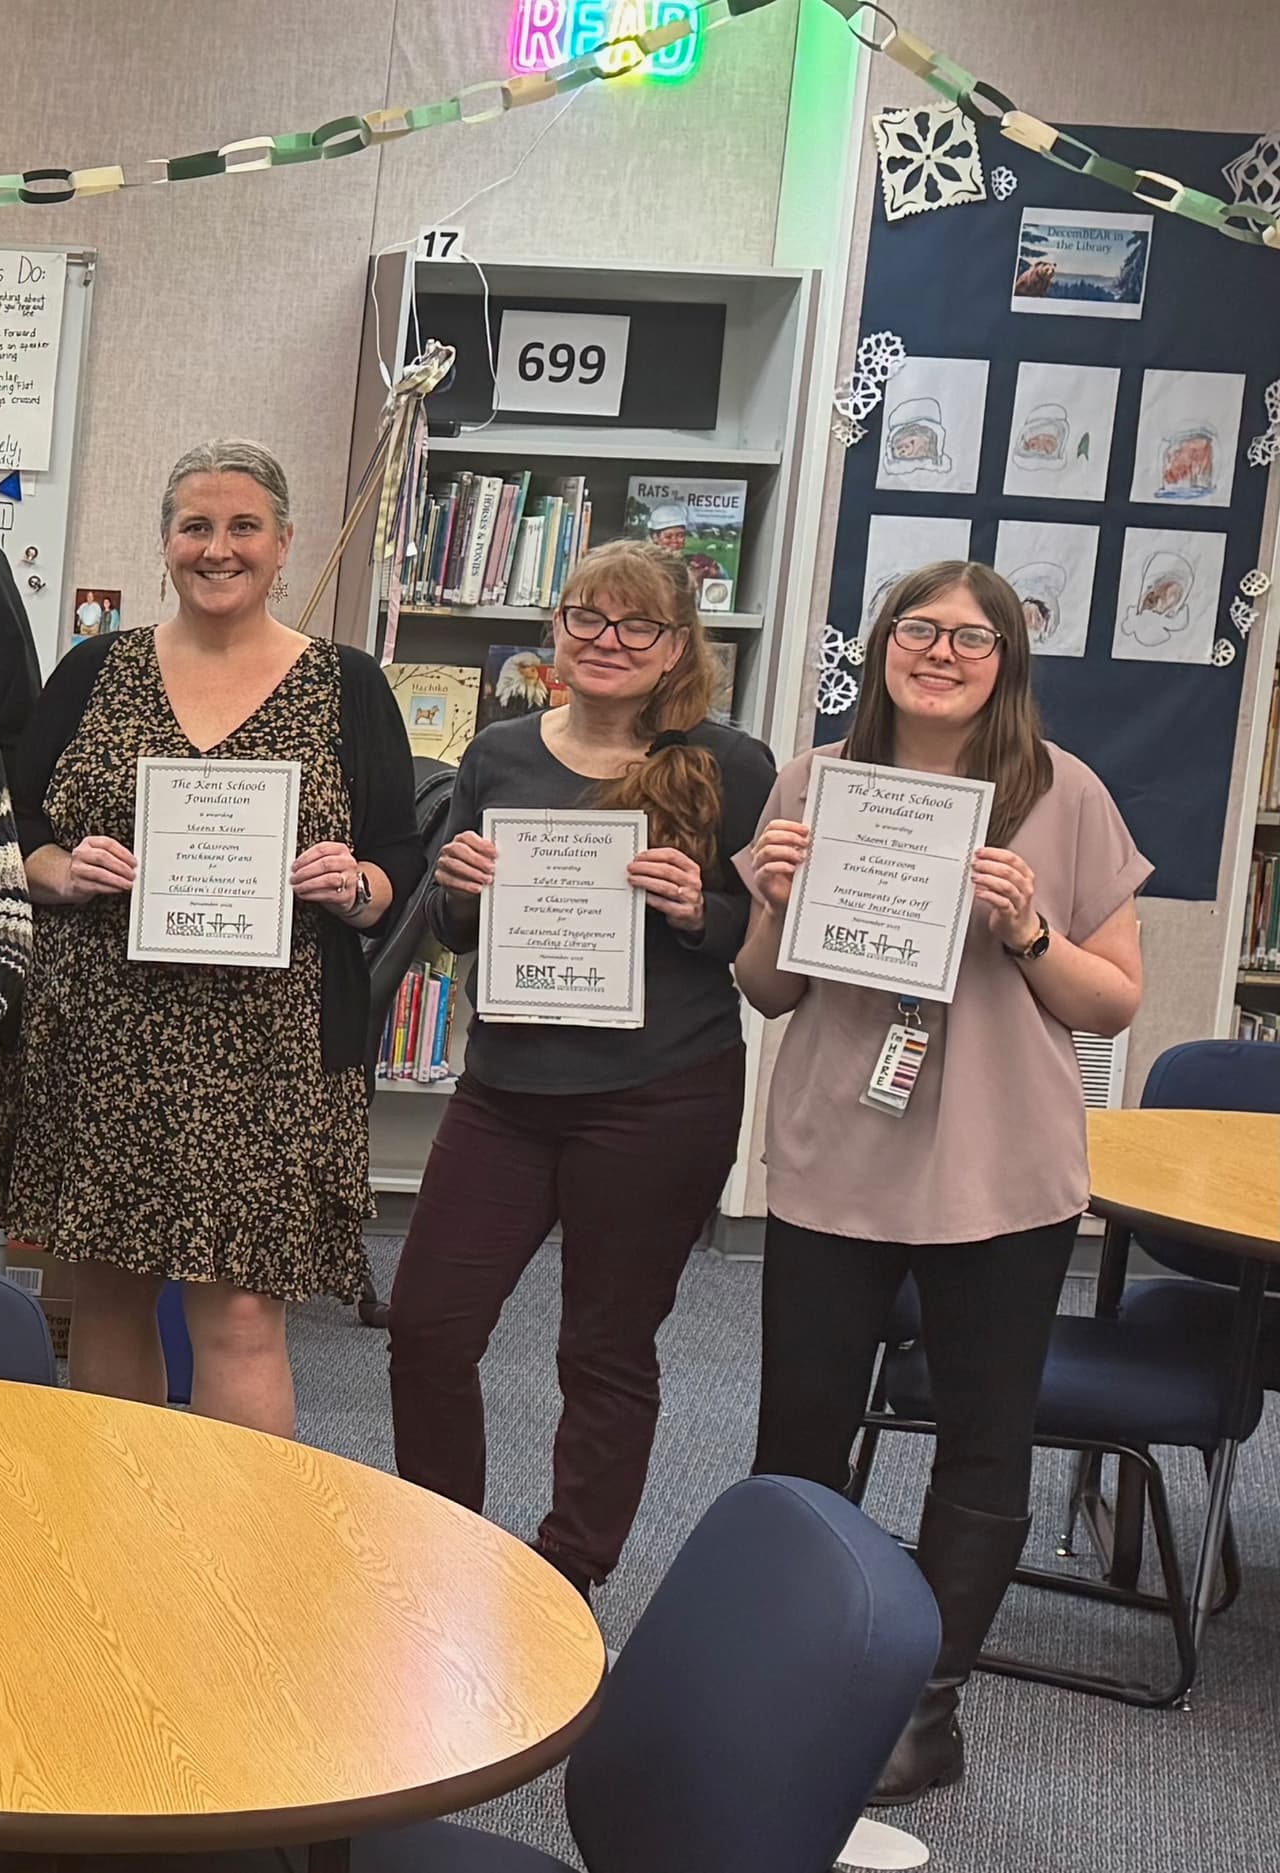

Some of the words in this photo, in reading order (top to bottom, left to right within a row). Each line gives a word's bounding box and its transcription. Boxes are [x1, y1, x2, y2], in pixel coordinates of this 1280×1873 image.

[511, 0, 700, 77] READ
[423, 231, 459, 258] 17
[1114, 232, 1123, 240] in
[1057, 240, 1073, 249] the
[1076, 241, 1111, 254] Library
[18, 256, 46, 284] Do:
[24, 293, 46, 302] about
[518, 341, 606, 384] 699
[638, 483, 670, 497] RATS
[688, 493, 739, 508] RESCUE
[480, 493, 494, 531] HORSES
[472, 541, 485, 577] PONIES
[172, 779, 191, 789] The
[194, 780, 222, 791] Kent
[227, 780, 266, 791] Schools
[185, 794, 250, 805] Foundation
[848, 784, 869, 797] The
[872, 788, 906, 805] Kent
[910, 793, 954, 810] Schools
[859, 802, 934, 822] Foundation
[518, 833, 537, 842] The
[540, 833, 568, 843] Kent
[573, 833, 612, 844] Schools
[892, 839, 927, 852] Burnett
[531, 847, 598, 858] Foundation
[833, 886, 890, 905] Instruments
[892, 895, 908, 908] for
[167, 912, 205, 926] KENT
[868, 903, 921, 919] Instruction
[825, 924, 868, 944] KENT
[516, 964, 555, 979] KENT
[876, 1043, 898, 1086] HERE
